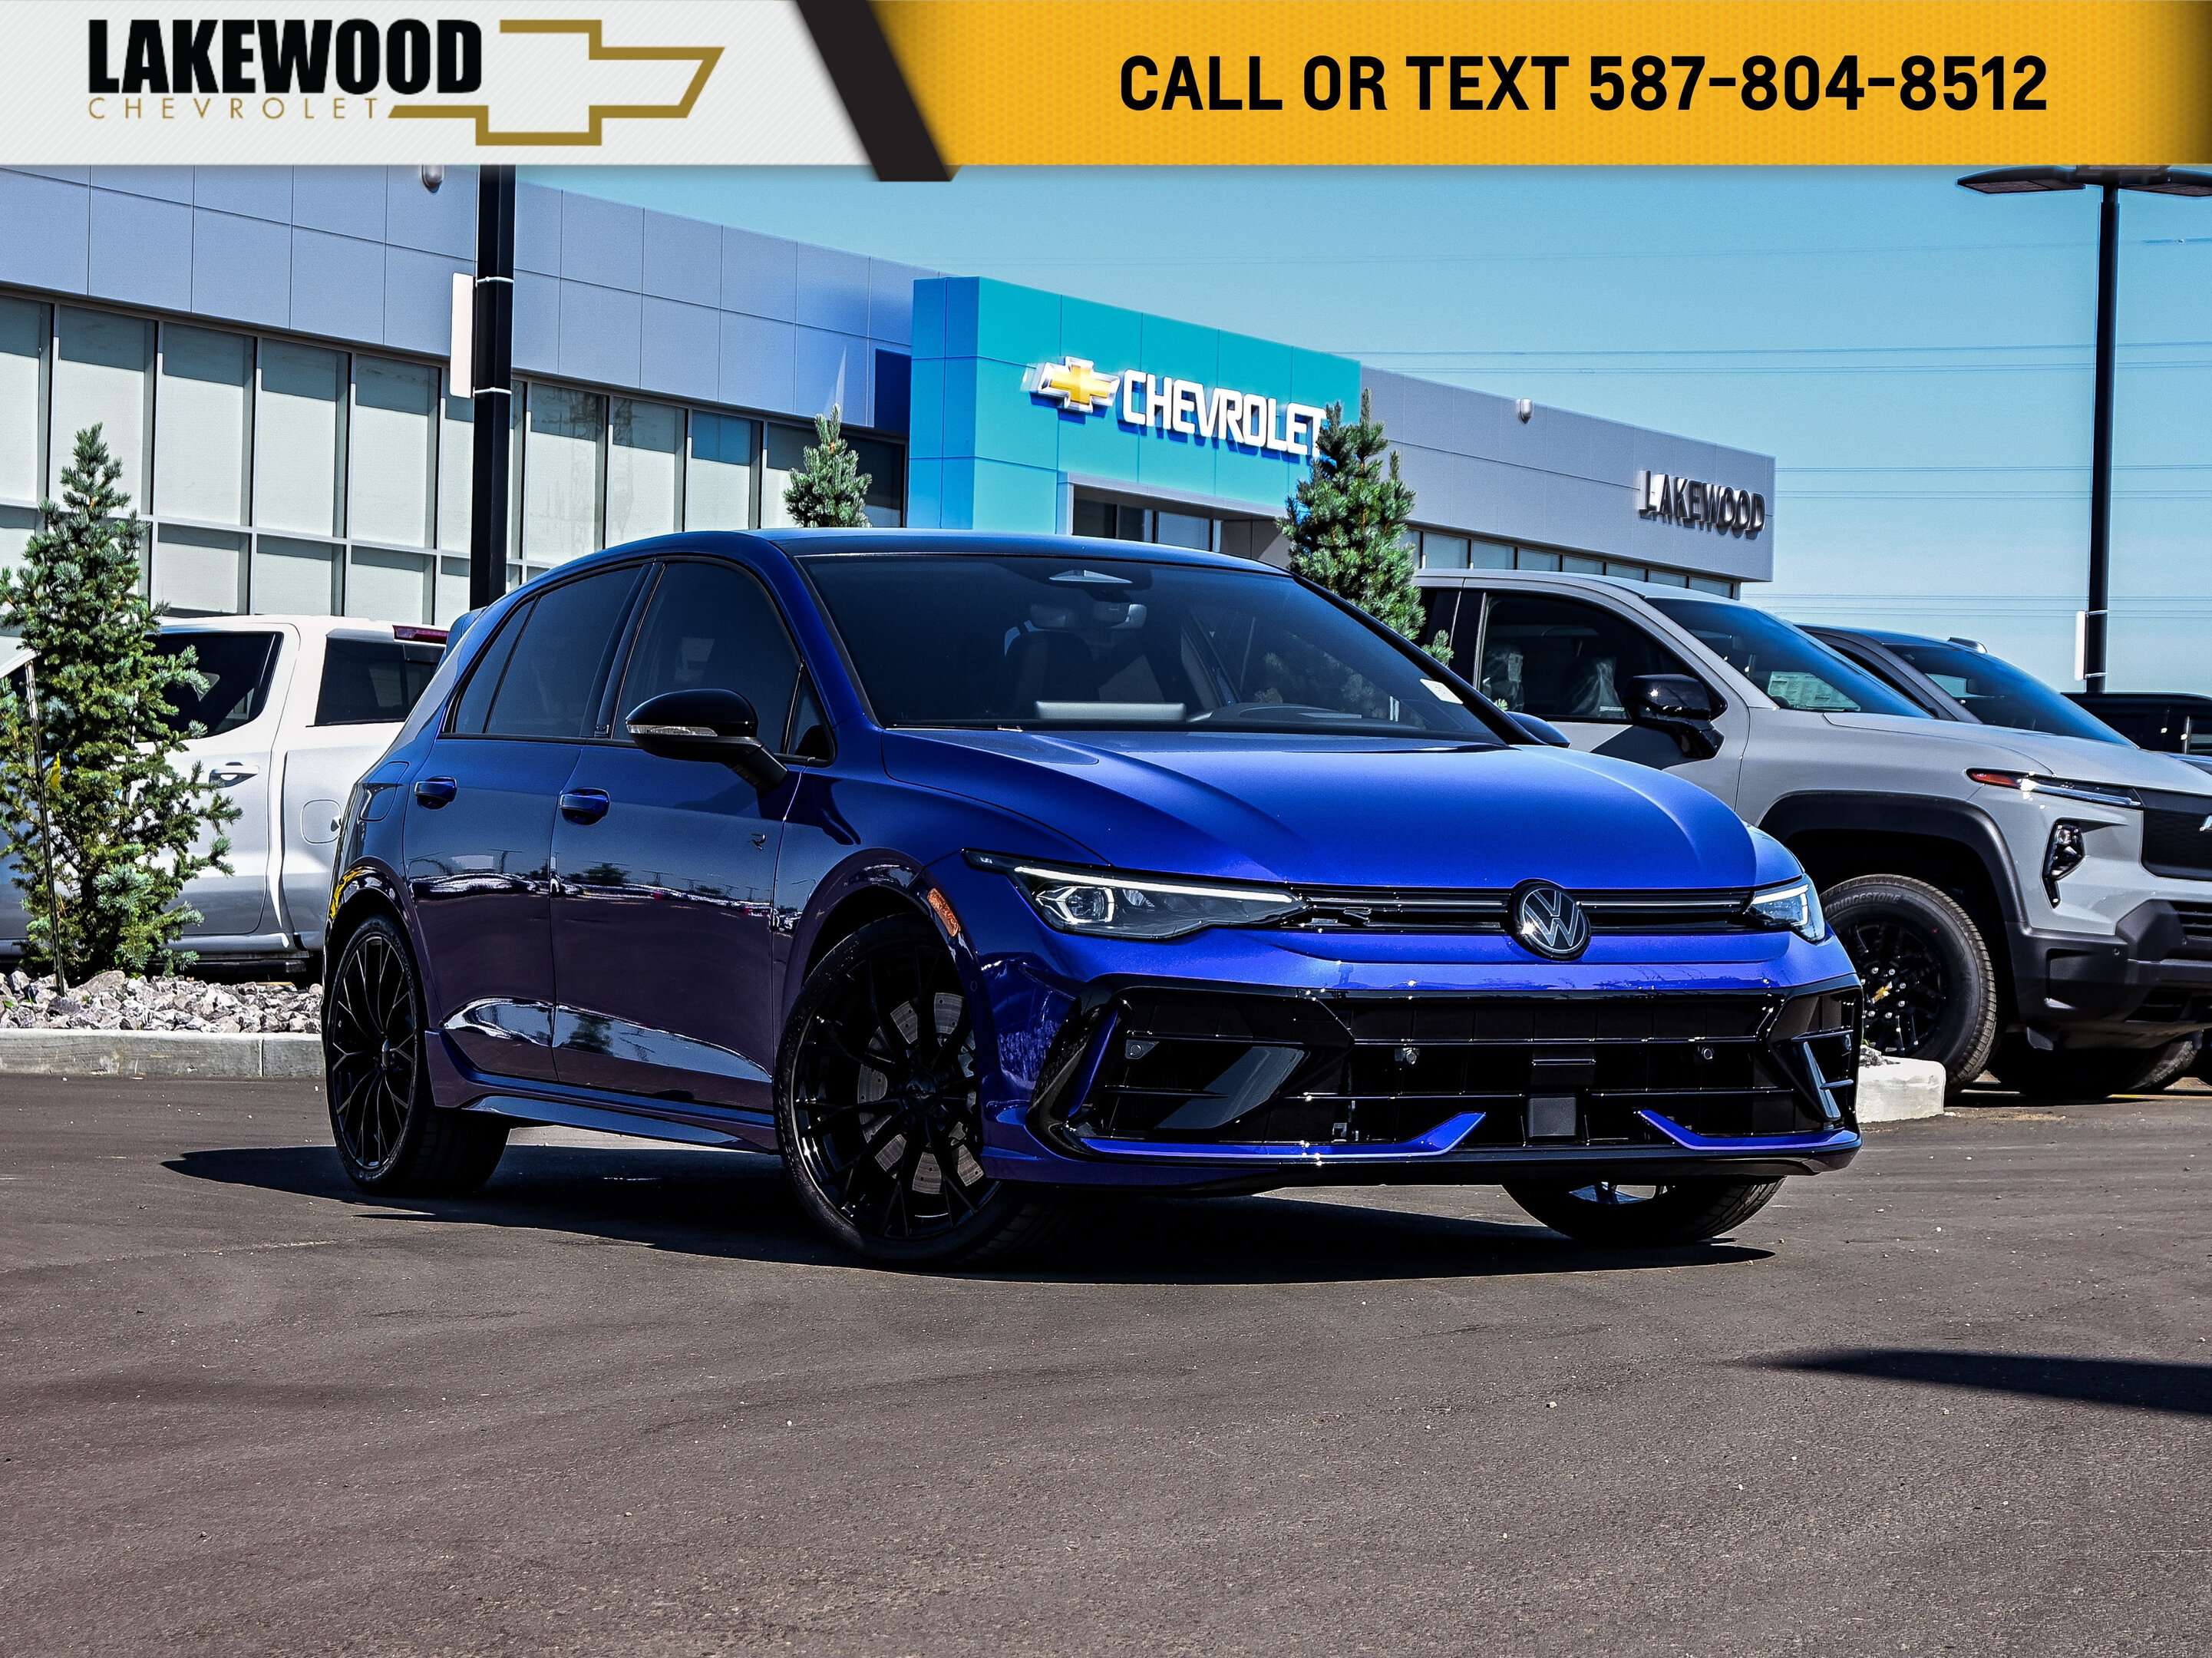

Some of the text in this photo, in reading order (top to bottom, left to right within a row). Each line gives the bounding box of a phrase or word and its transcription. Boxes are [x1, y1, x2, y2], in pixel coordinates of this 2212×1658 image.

[1122, 369, 1328, 458] CHEVROLET
[1639, 471, 1765, 532] LAKEWOOD
[1522, 888, 1584, 951] VW
